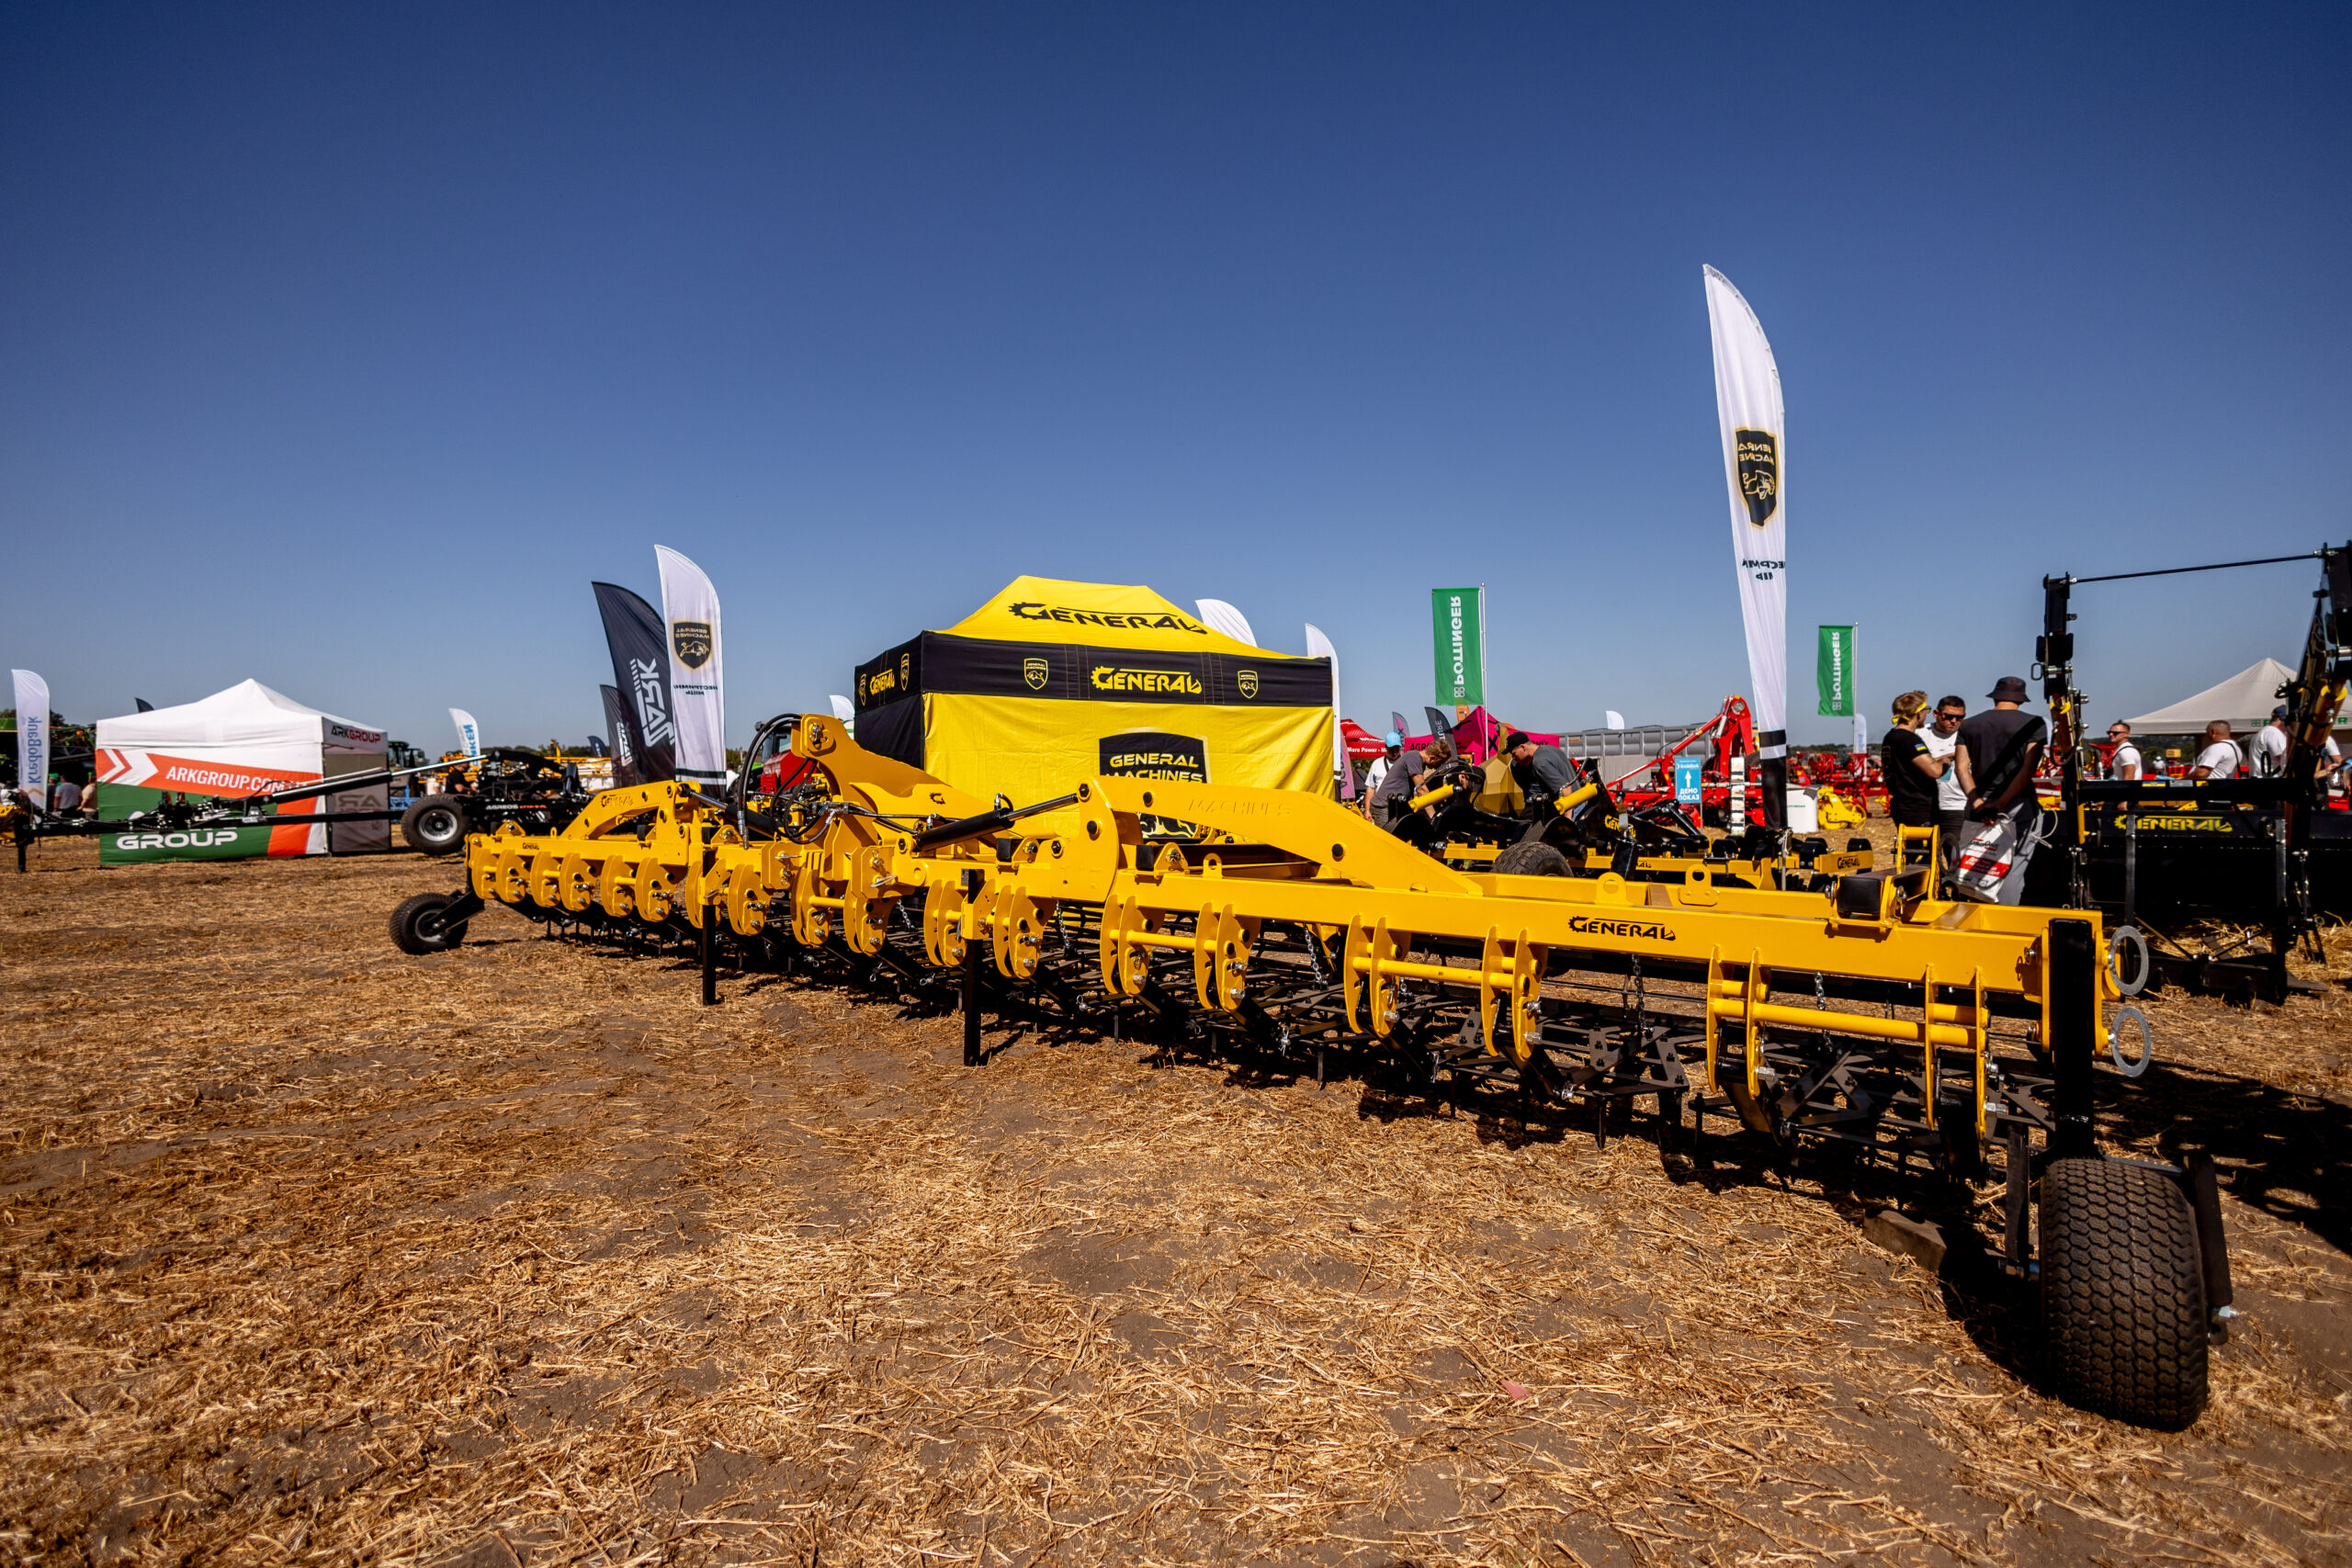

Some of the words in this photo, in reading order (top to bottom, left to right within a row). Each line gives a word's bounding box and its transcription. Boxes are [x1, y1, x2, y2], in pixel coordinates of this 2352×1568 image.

[1008, 601, 1208, 635] GENERAL
[1091, 665, 1203, 695] GENERAL
[331, 725, 381, 744] ARKGROUP
[1110, 752, 1199, 768] GENERAL
[165, 765, 307, 793] ARKGROUP.COM
[116, 830, 238, 851] GROUP
[1567, 915, 1676, 942] GENERAL
